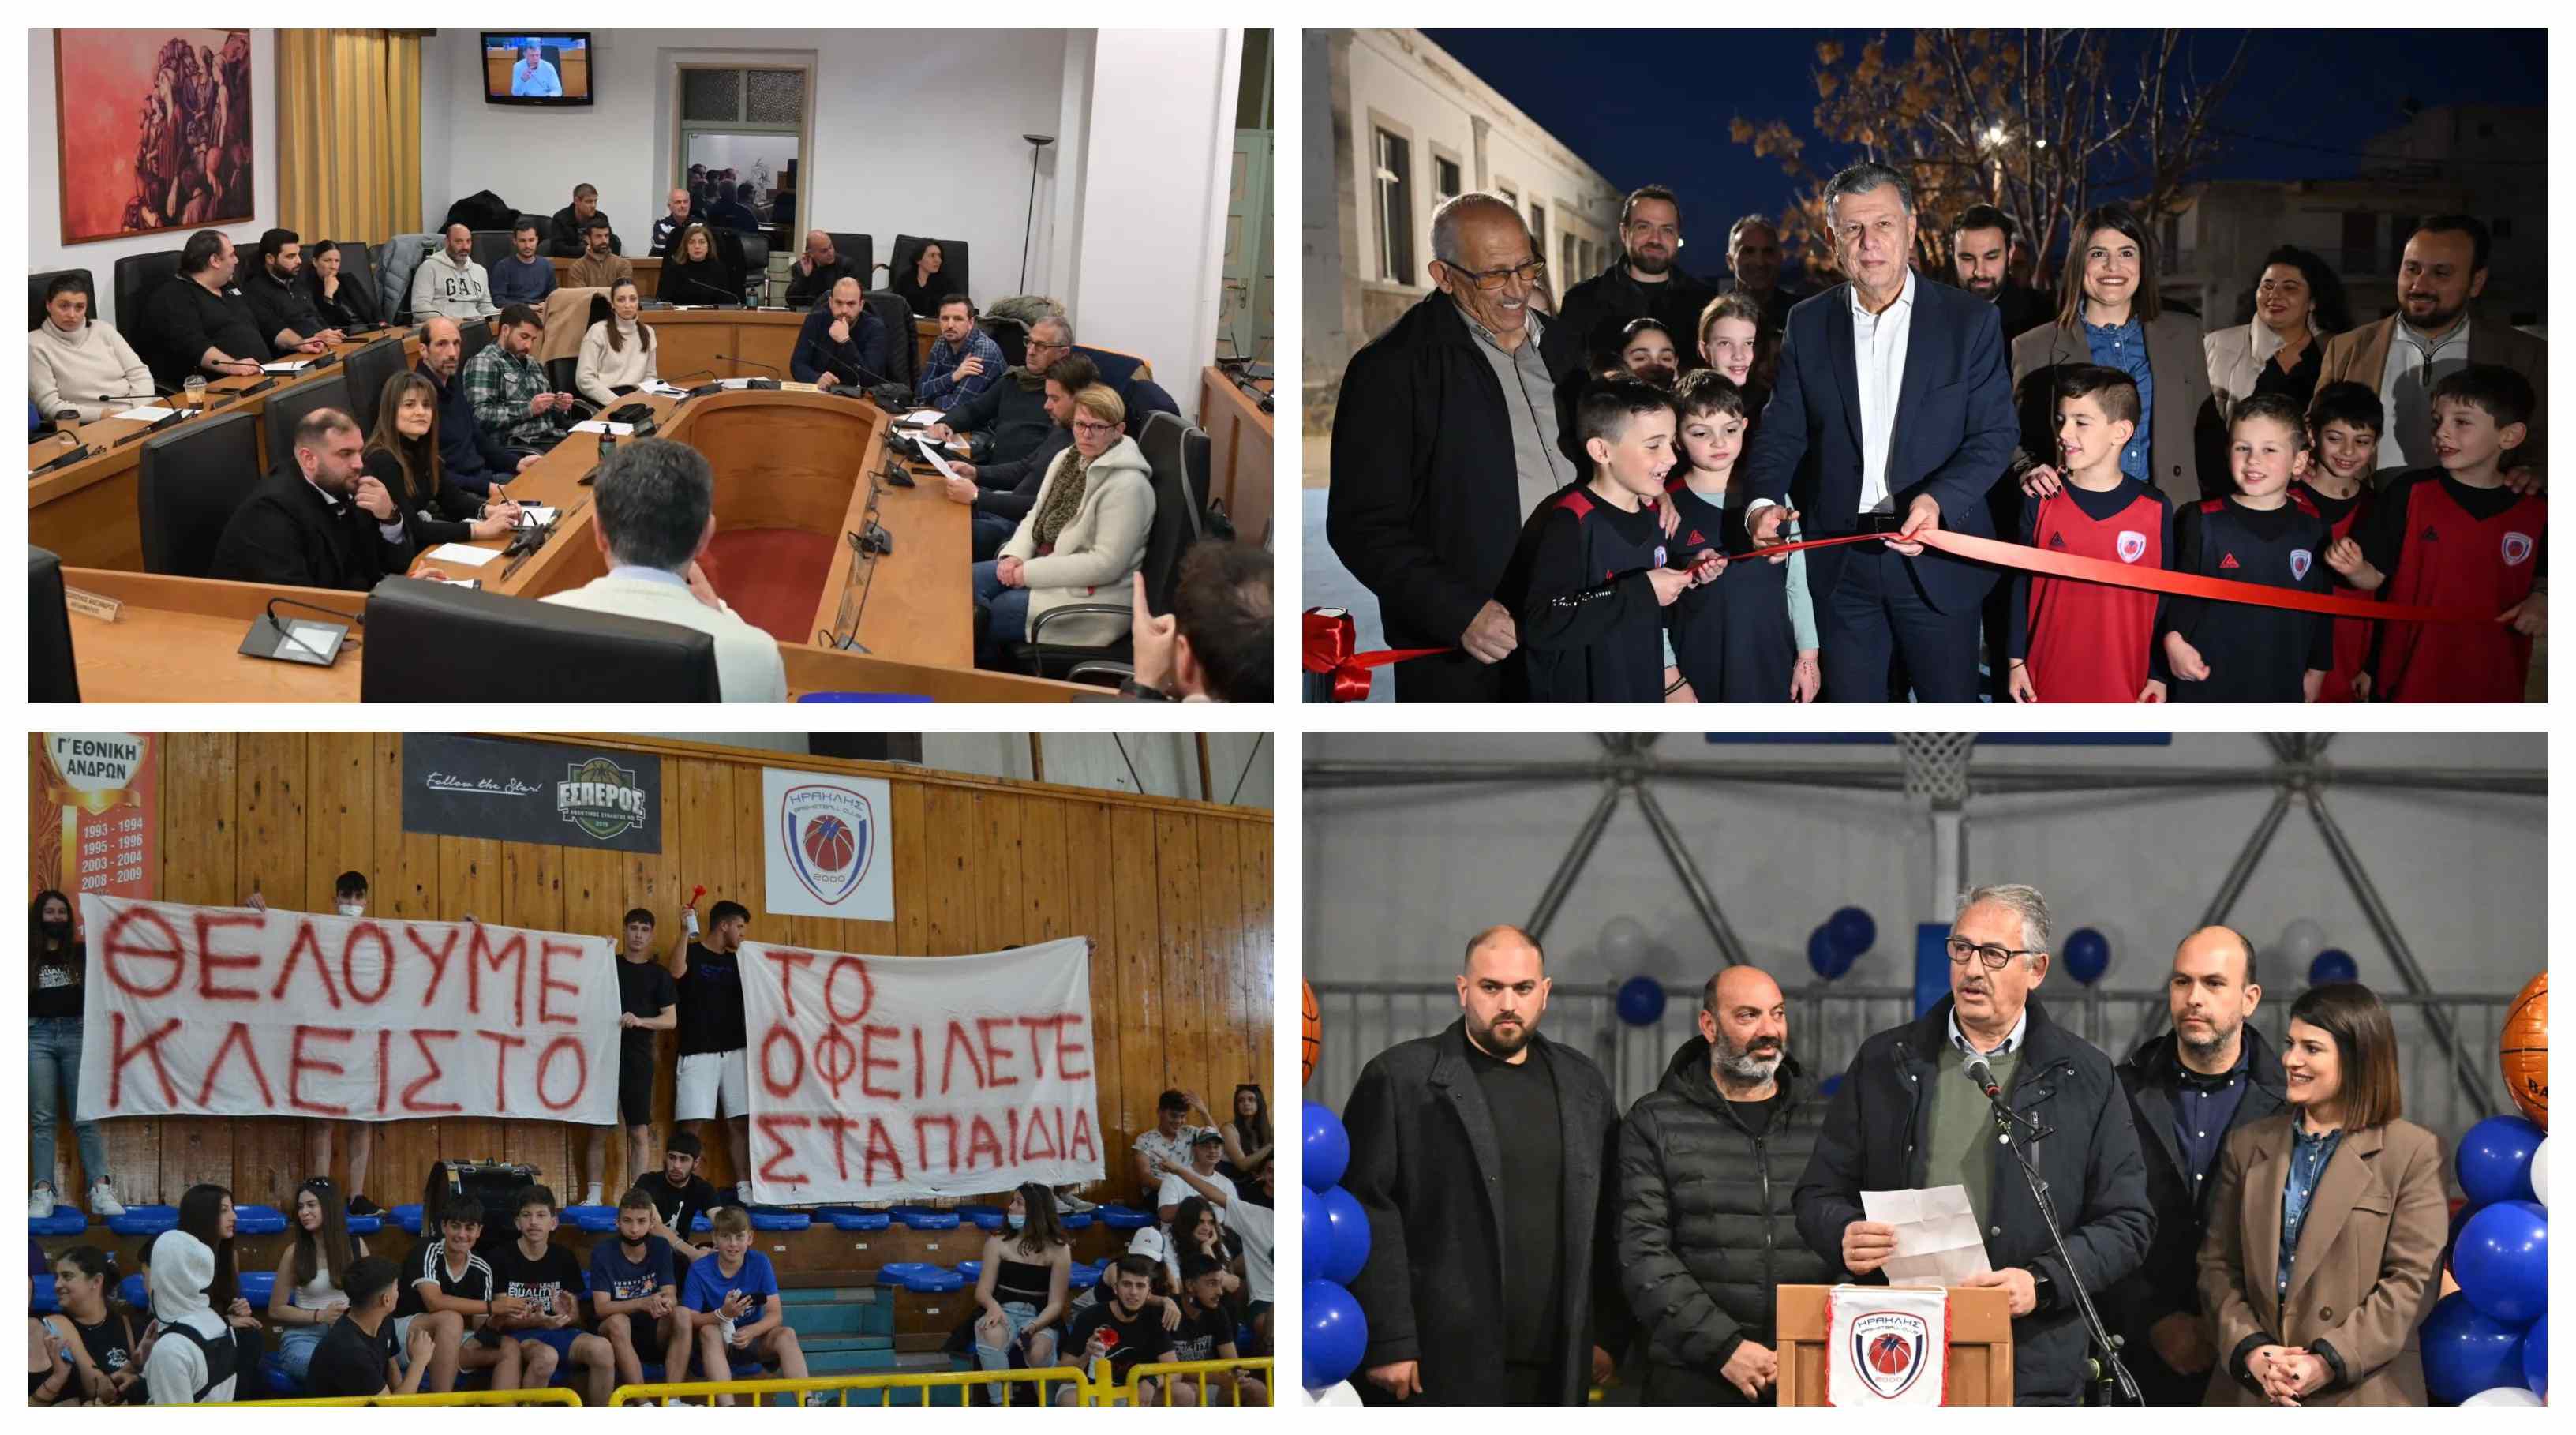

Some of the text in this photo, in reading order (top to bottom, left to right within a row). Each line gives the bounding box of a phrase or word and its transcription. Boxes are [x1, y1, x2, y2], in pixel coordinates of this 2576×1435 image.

[445, 278, 481, 297] GAP
[67, 759, 126, 780] ΑΝΔΡΩΝ
[426, 771, 474, 789] Follow
[477, 778, 500, 789] the
[560, 781, 643, 815] ΕΣΠΕΡΟΣ
[789, 792, 865, 811] ΗΡΑΚΛΗΣ
[84, 823, 108, 838] 1993
[118, 817, 143, 832] 1994
[84, 840, 108, 856] 1995
[118, 834, 143, 849] 1996
[82, 856, 107, 873] 2003
[117, 851, 143, 867] 2004
[82, 874, 107, 890] 2008
[117, 867, 143, 883] 2009
[813, 873, 845, 883] 2000
[102, 905, 584, 1027] ΘΕΛΟΥΜΕ
[764, 950, 874, 1025] ΤΟ
[108, 1010, 588, 1115] ΚΛΕΙΣΤΟ
[759, 1014, 1091, 1100] ΟΦΕΙΛΕΤΕ
[1857, 1317, 1921, 1329] ΗΡΑΚΛΗΣ
